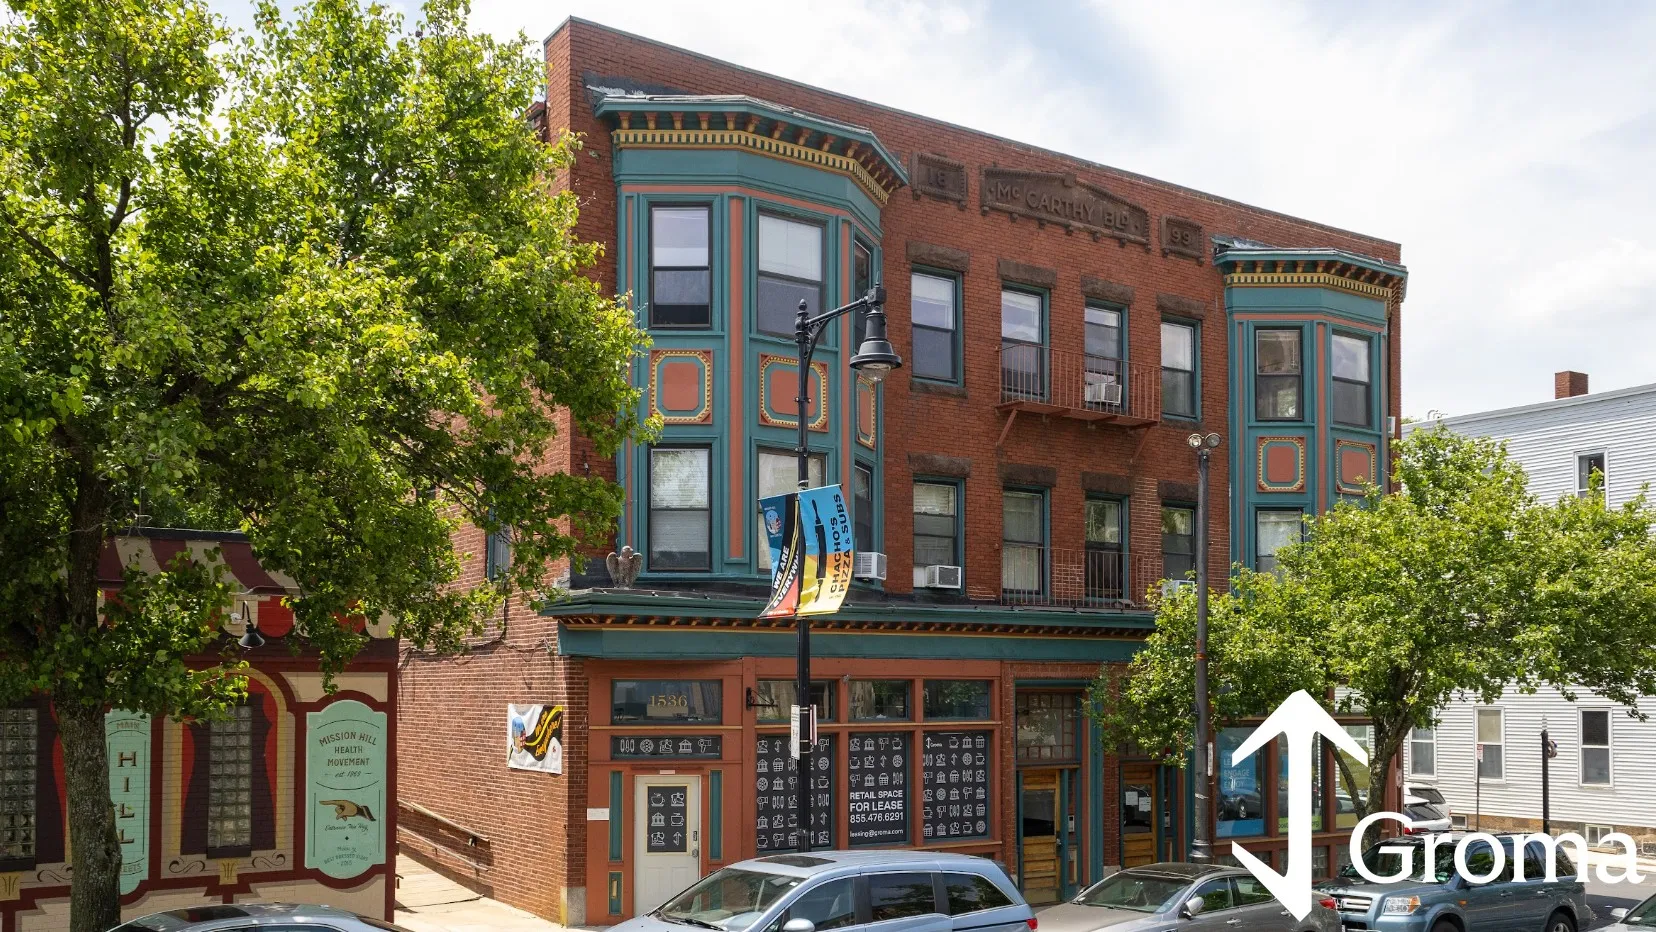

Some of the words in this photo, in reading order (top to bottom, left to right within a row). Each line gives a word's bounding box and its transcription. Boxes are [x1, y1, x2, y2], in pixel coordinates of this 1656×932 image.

[1171, 227, 1192, 246] 99
[834, 493, 849, 533] SUBS
[830, 517, 841, 593] CHACHO'S
[774, 570, 784, 589] WE
[780, 545, 789, 570] ARE
[838, 549, 850, 592] PIZZA
[650, 694, 688, 707] 1536
[319, 731, 357, 747] MISSION
[358, 732, 377, 746] HILL
[334, 746, 363, 754] HEALTH
[327, 758, 370, 767] MOVEMENT
[1223, 769, 1250, 777] ENGAGE
[850, 791, 877, 800] RETAIL
[878, 789, 903, 799] SPACE
[850, 802, 870, 812] FOR
[872, 800, 904, 811] LEASE
[850, 812, 904, 824] 855.476.6291
[850, 829, 904, 838] leasing@groma.com
